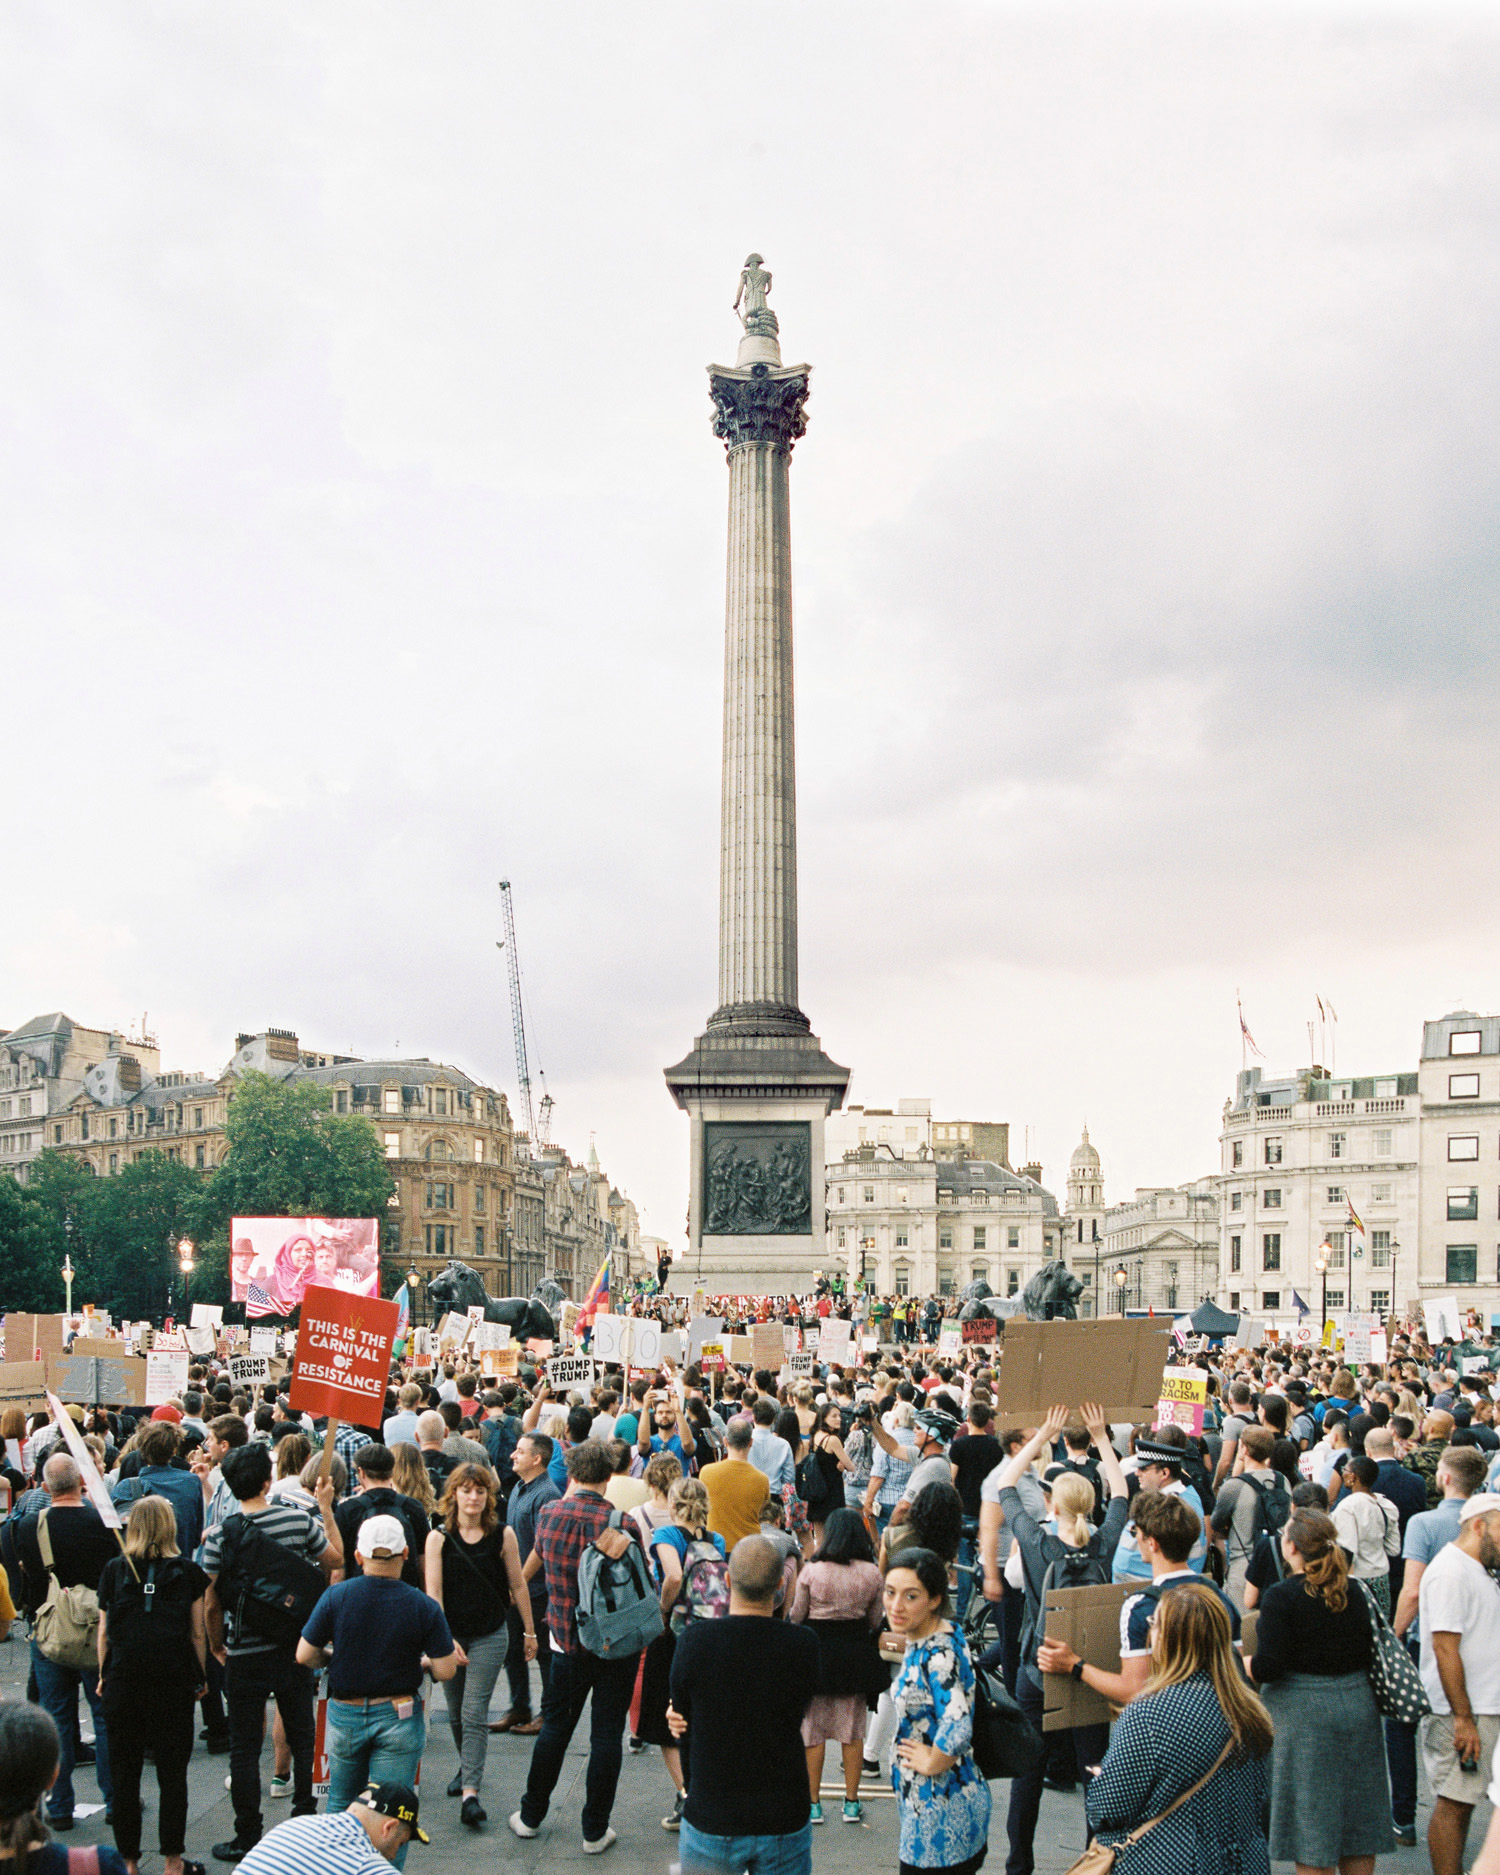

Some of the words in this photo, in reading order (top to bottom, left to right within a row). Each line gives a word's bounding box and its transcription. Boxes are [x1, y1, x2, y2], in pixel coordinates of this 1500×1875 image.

[962, 1320, 993, 1331] TRUMP
[306, 1318, 340, 1336] THIS
[343, 1326, 356, 1341] IS
[360, 1330, 387, 1349] THE
[597, 1320, 658, 1360] BOO
[309, 1334, 380, 1362] CARNIVAL
[231, 1358, 266, 1371] #DUMP
[333, 1354, 354, 1370] OF
[791, 1355, 811, 1363] #DUMP
[551, 1359, 591, 1373] #DUMP
[791, 1363, 811, 1371] TRUMP
[233, 1368, 266, 1380] TRUMP
[298, 1362, 382, 1392] RESISTANCE
[552, 1370, 590, 1383] TRUMP
[1162, 1379, 1176, 1389] NO
[1180, 1380, 1193, 1391] TO
[1160, 1388, 1199, 1401] RACISM
[1158, 1401, 1174, 1412] NO
[397, 1805, 415, 1821] 1ST
